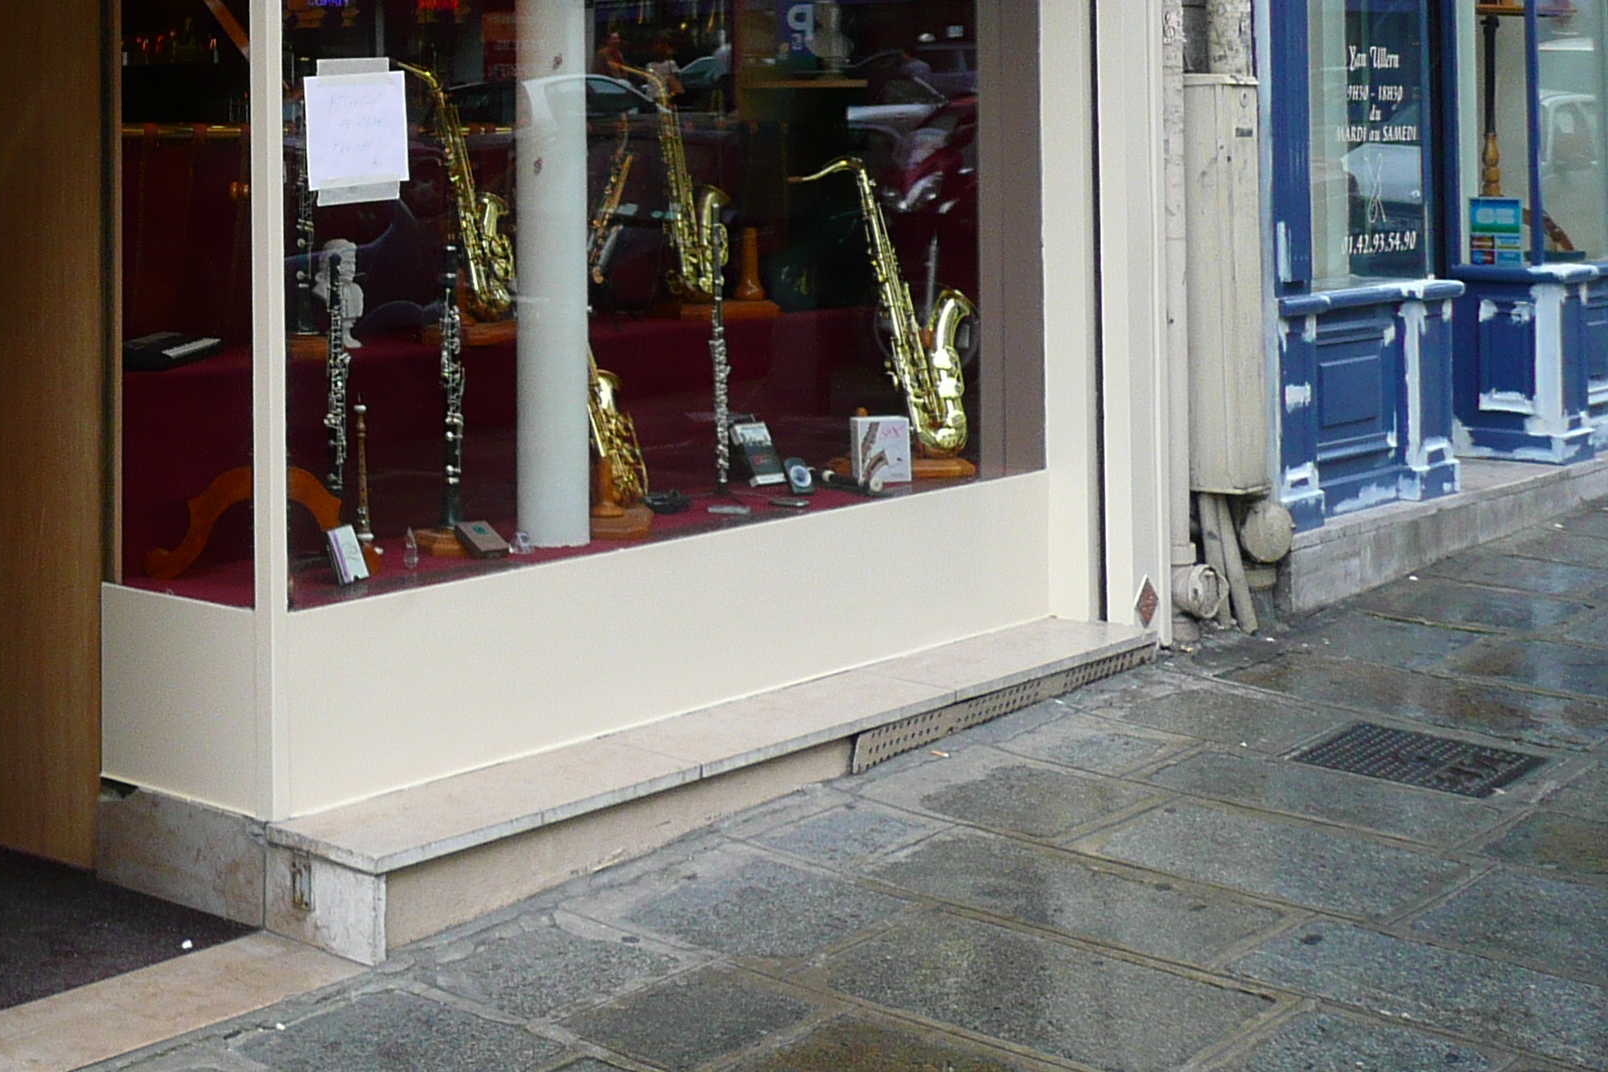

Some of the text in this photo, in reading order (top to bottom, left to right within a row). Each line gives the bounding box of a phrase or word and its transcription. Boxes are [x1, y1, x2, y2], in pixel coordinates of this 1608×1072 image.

[1369, 104, 1382, 121] du
[1336, 126, 1367, 142] MARDI
[1382, 126, 1417, 142] SAMEDI
